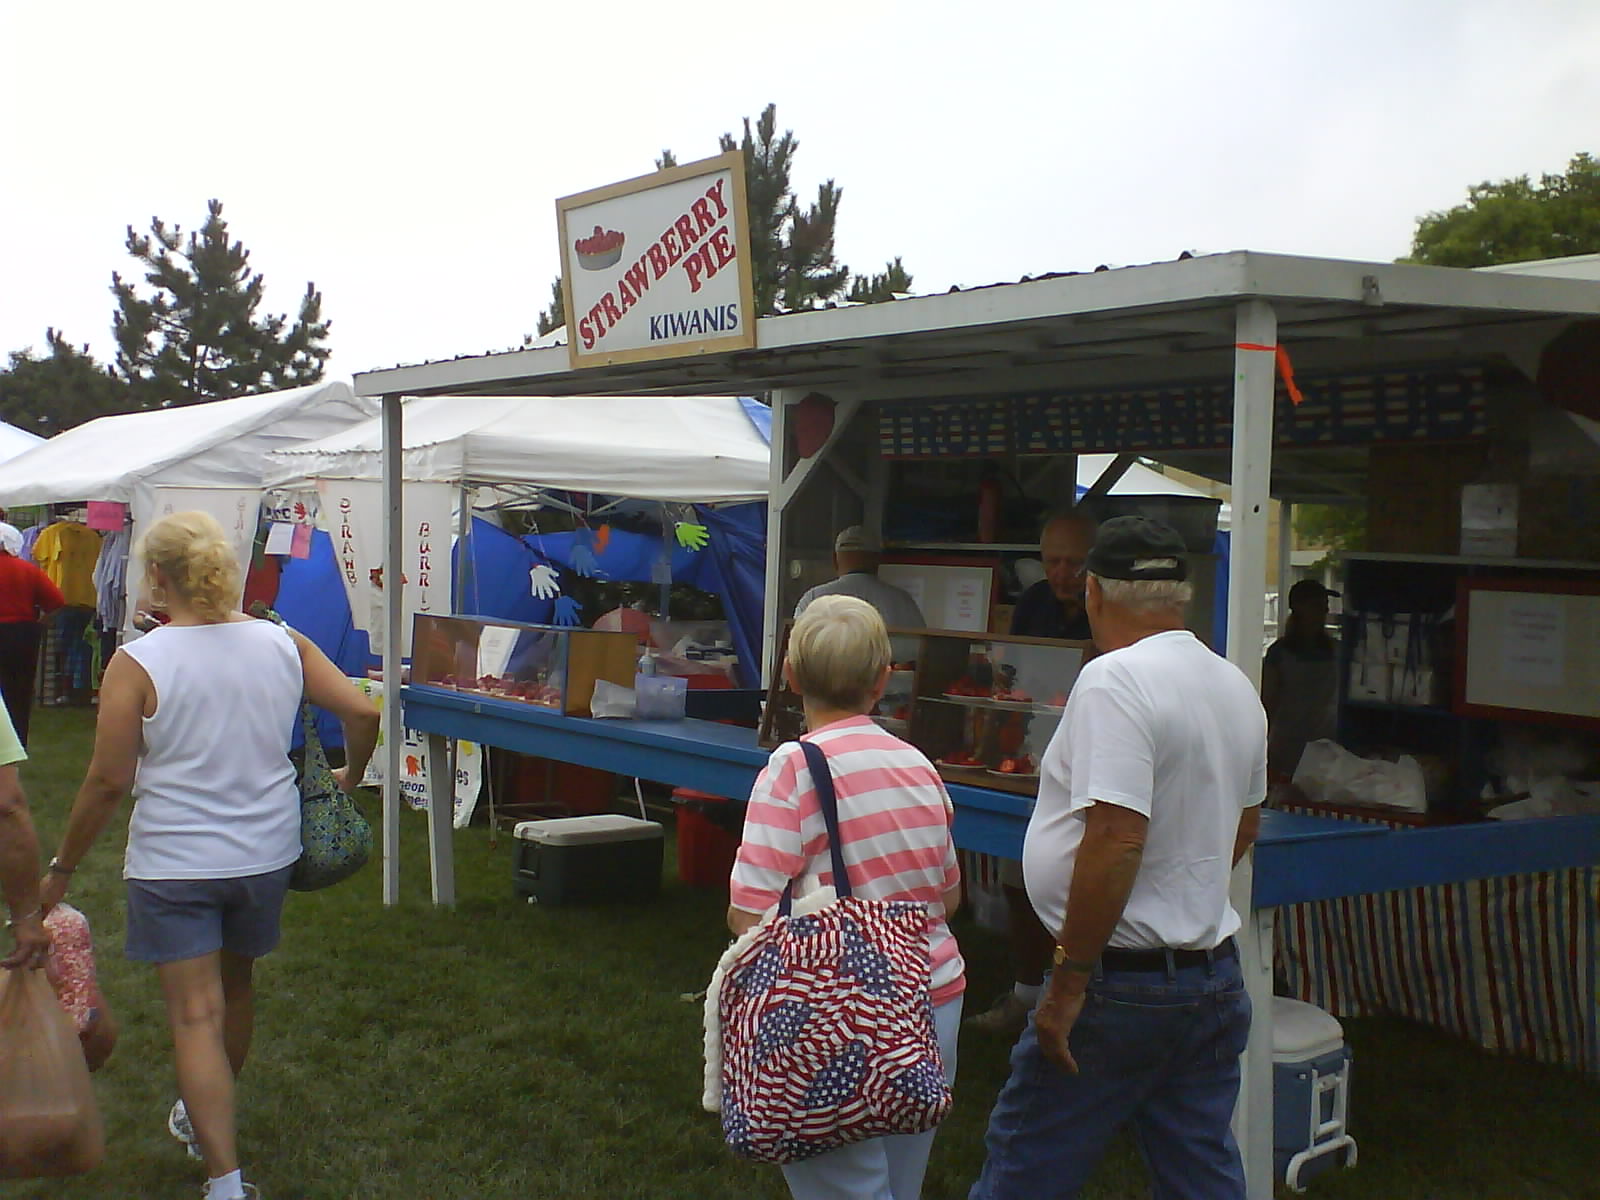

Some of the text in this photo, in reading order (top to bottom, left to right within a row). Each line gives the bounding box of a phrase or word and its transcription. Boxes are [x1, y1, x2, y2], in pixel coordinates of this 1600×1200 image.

[579, 178, 728, 350] STRAWBERRY
[682, 225, 738, 294] PIE
[650, 303, 739, 341] KIWANIS
